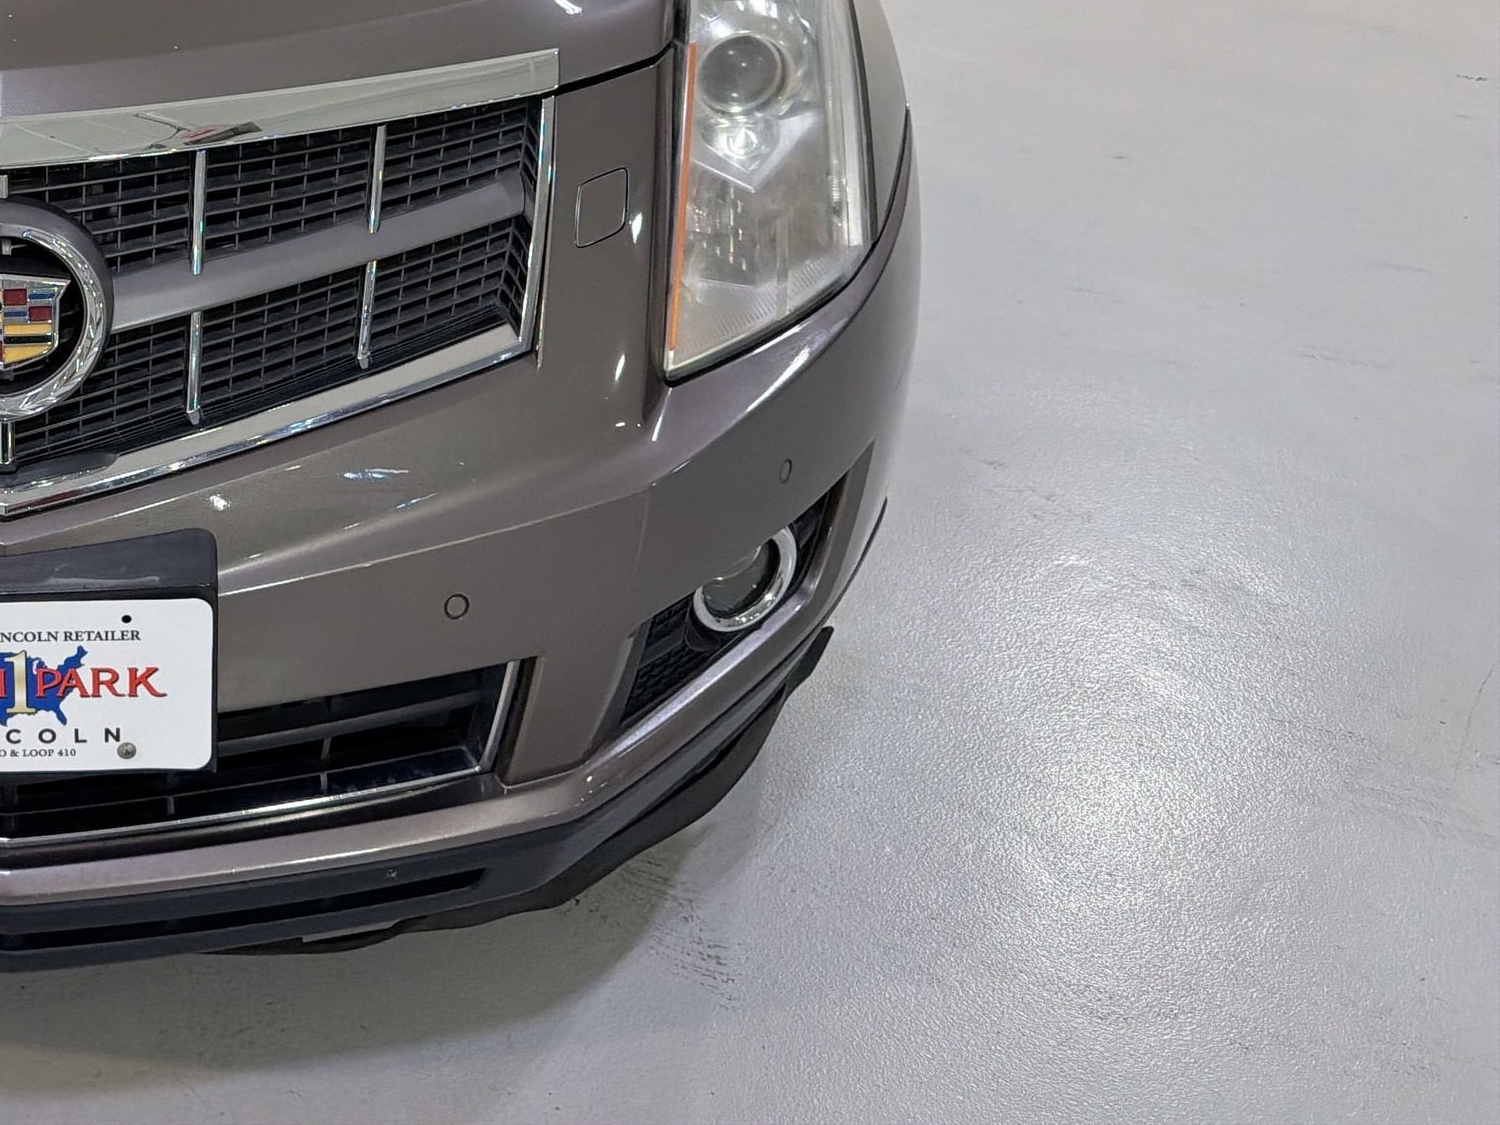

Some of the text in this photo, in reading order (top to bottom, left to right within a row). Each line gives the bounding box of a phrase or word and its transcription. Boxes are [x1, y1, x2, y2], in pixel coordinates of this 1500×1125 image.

[63, 629, 142, 643] RETAILER
[35, 666, 168, 699] PARK
[9, 748, 19, 757] &
[21, 748, 55, 757] LOOP
[57, 748, 77, 757] 410
